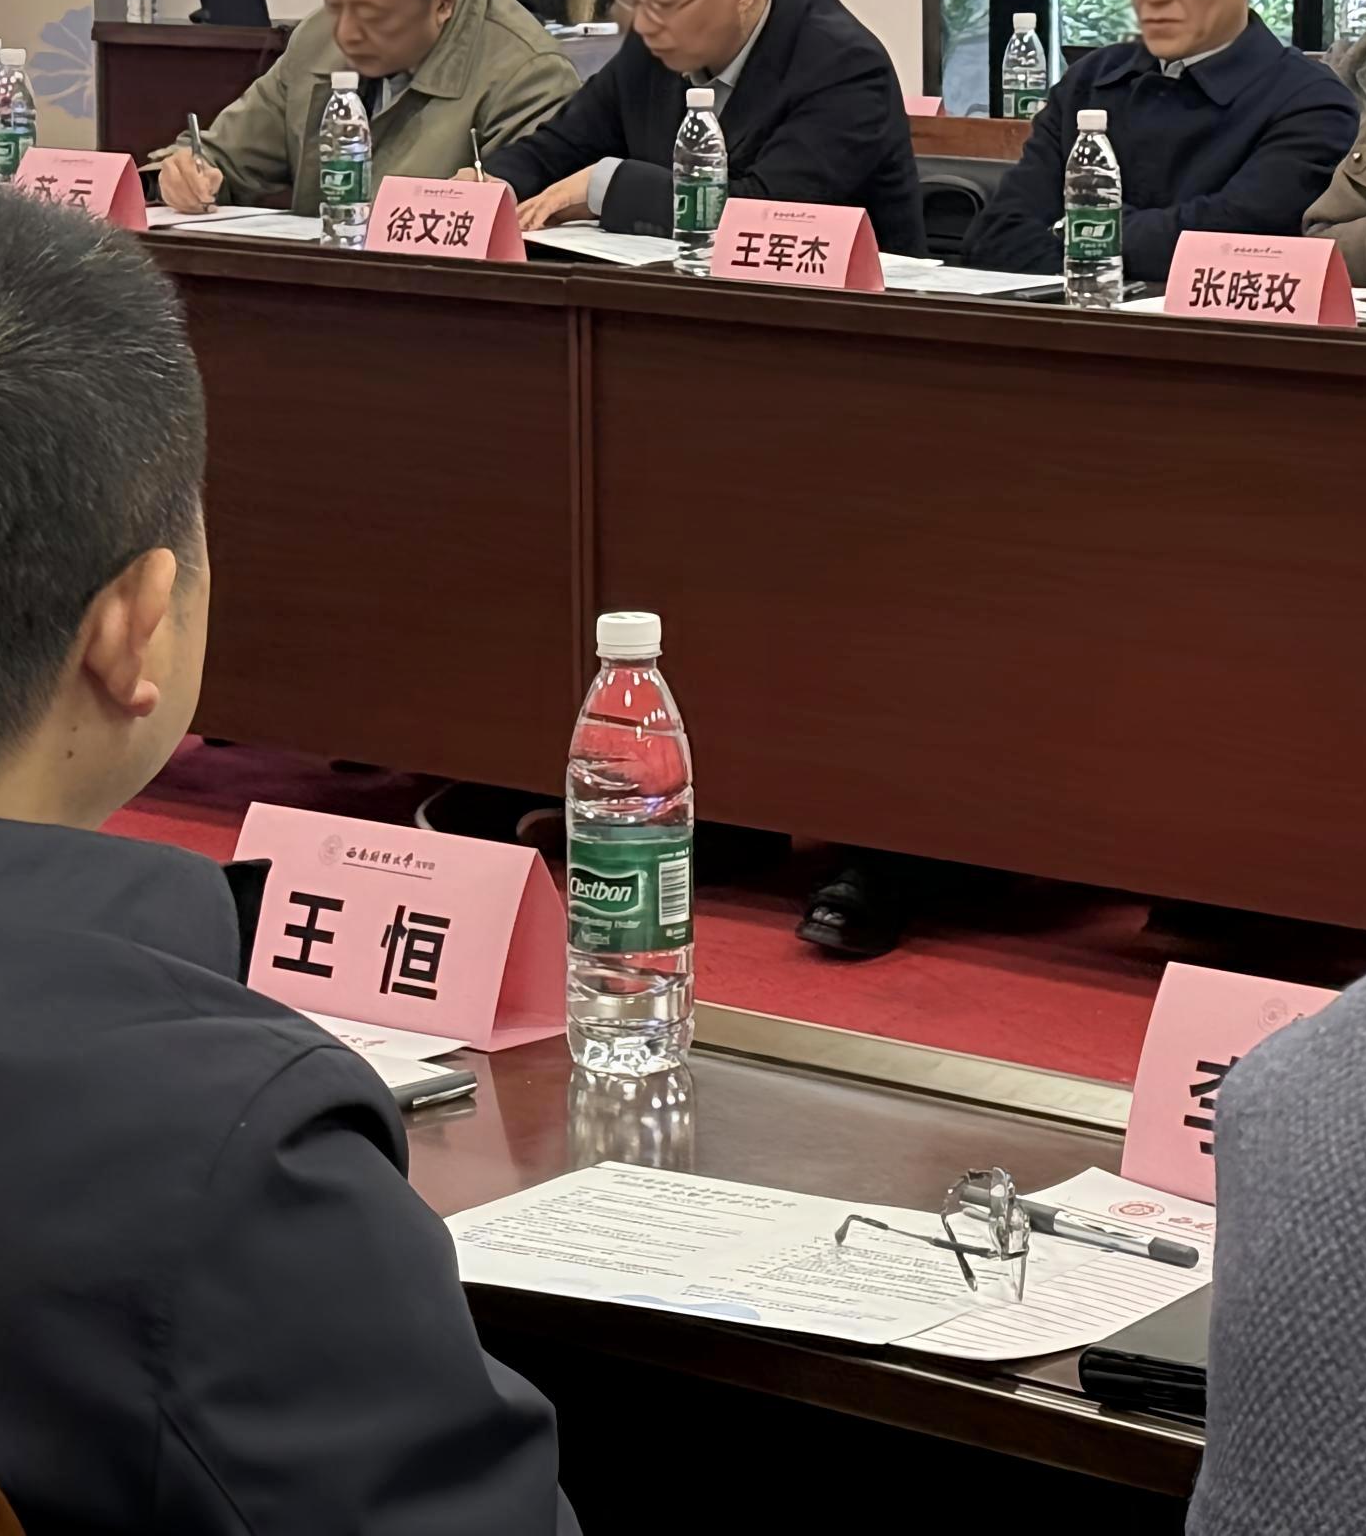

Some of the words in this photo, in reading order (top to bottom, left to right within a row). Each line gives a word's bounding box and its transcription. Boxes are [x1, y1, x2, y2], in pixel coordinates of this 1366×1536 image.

[387, 206, 474, 247] 徐文波
[730, 231, 830, 274] 王军杰
[1189, 267, 1302, 313] 张晓玫
[272, 890, 451, 1000] 王恒
